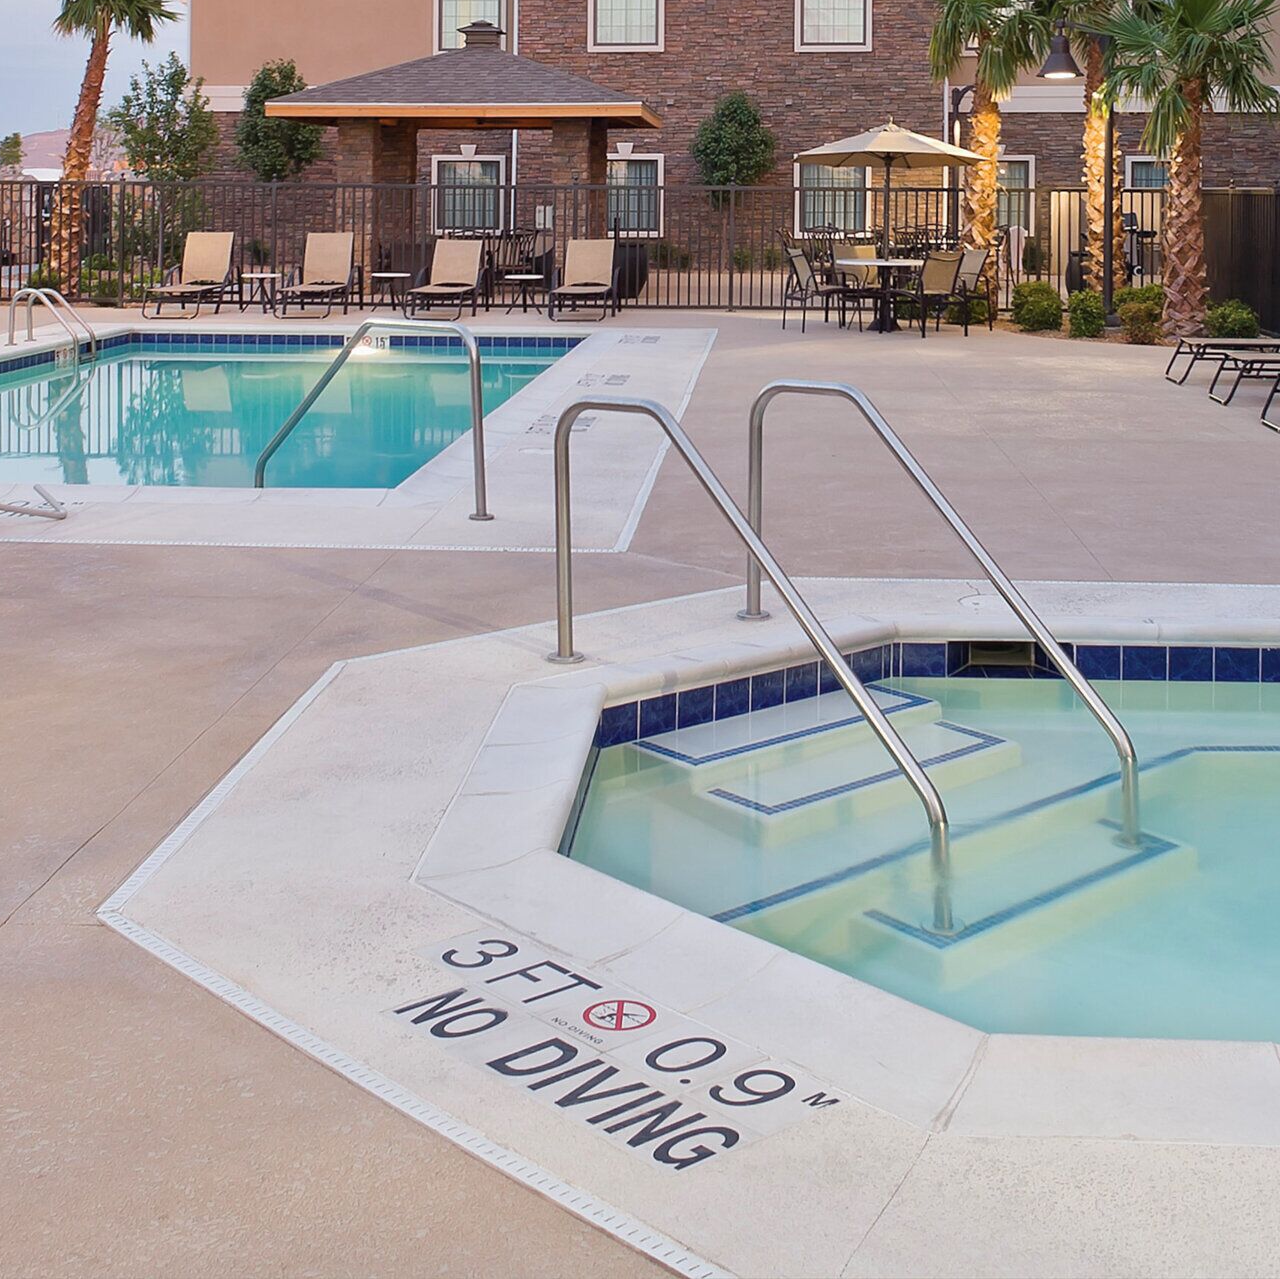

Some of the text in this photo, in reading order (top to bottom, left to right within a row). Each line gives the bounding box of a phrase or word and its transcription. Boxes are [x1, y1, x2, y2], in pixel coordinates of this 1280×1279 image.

[393, 987, 740, 1171] NO DIVING
[441, 939, 840, 1108] 3 FT 0.9 M
